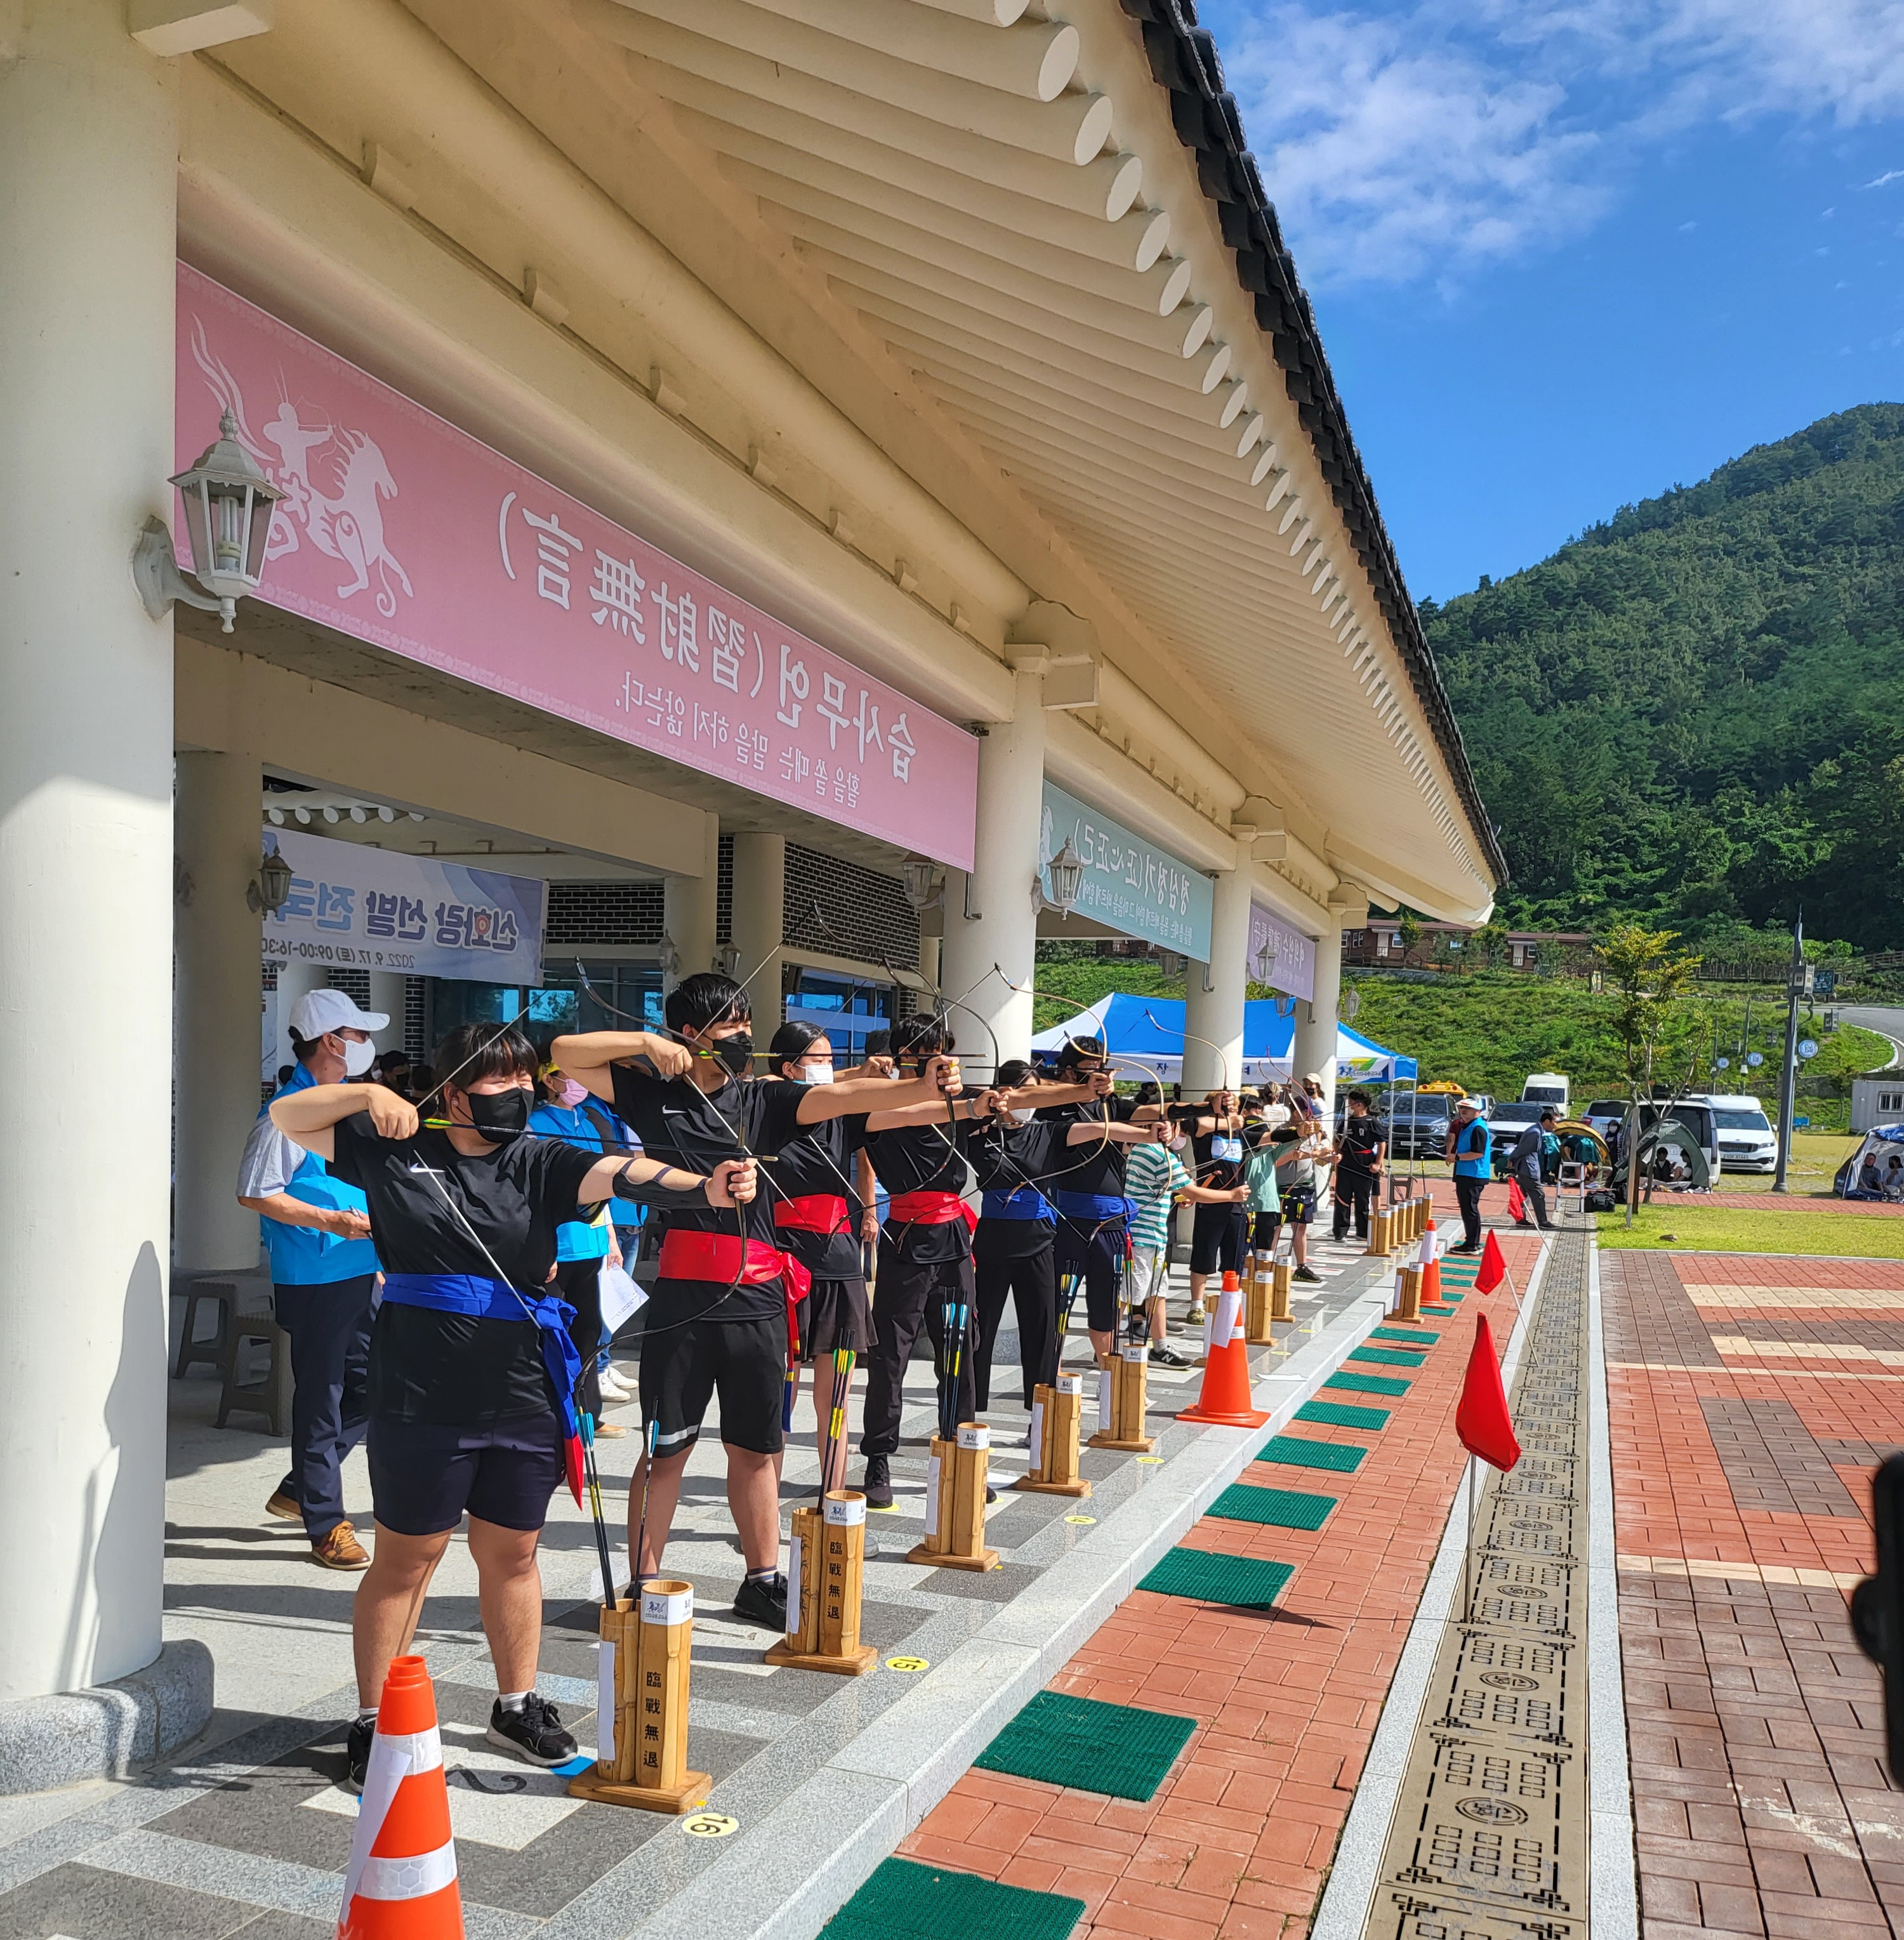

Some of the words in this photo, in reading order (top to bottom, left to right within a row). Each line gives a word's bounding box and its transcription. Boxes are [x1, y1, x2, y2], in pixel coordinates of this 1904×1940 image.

[827, 1541, 843, 1620] 臨戰無退
[892, 1658, 923, 1670] 15
[643, 1670, 661, 1769] 臨戰無退
[690, 1816, 730, 1835] 16
